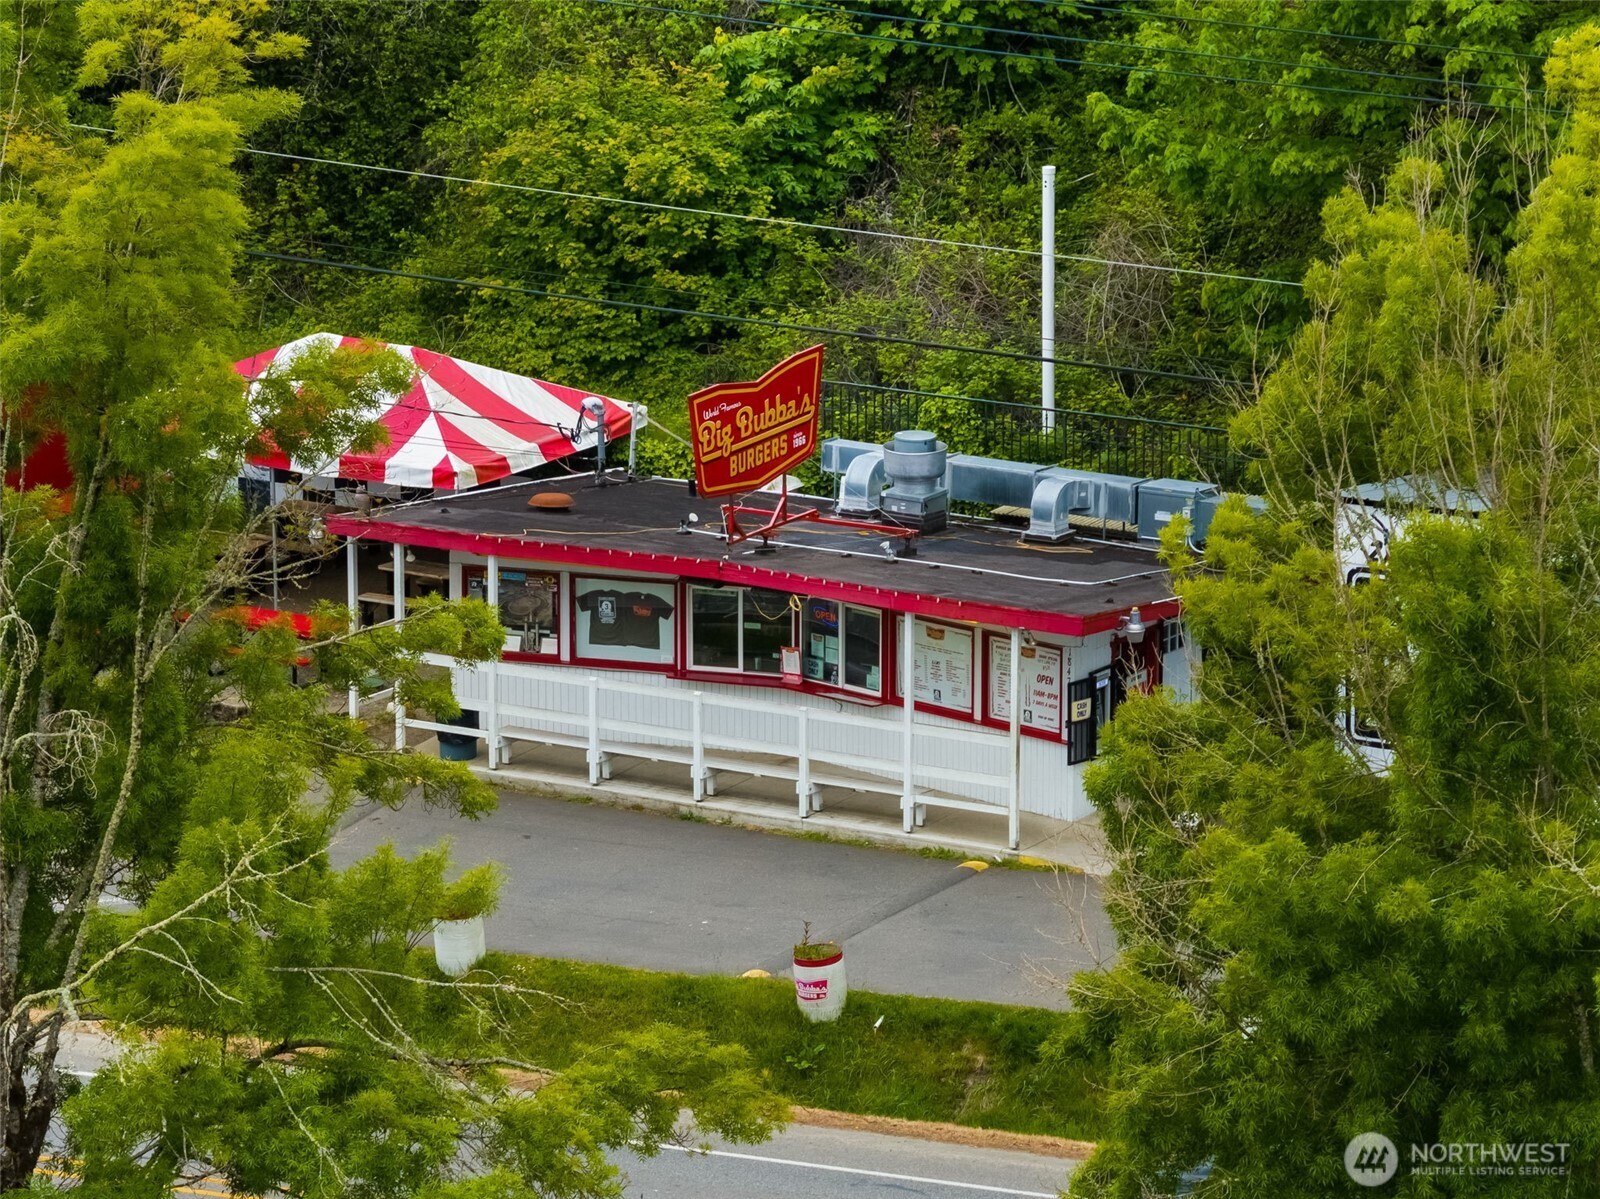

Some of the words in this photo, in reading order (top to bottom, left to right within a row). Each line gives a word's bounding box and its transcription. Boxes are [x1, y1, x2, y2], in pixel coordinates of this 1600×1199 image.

[703, 406, 720, 420] World
[720, 401, 742, 412] Famous
[698, 420, 735, 458] Big
[736, 386, 815, 438] Bubba's
[730, 434, 788, 477] BURGERS
[815, 610, 837, 623] OPEN
[1036, 673, 1054, 686] OPEN
[1077, 702, 1087, 710] CASH
[1077, 710, 1087, 718] ONLY
